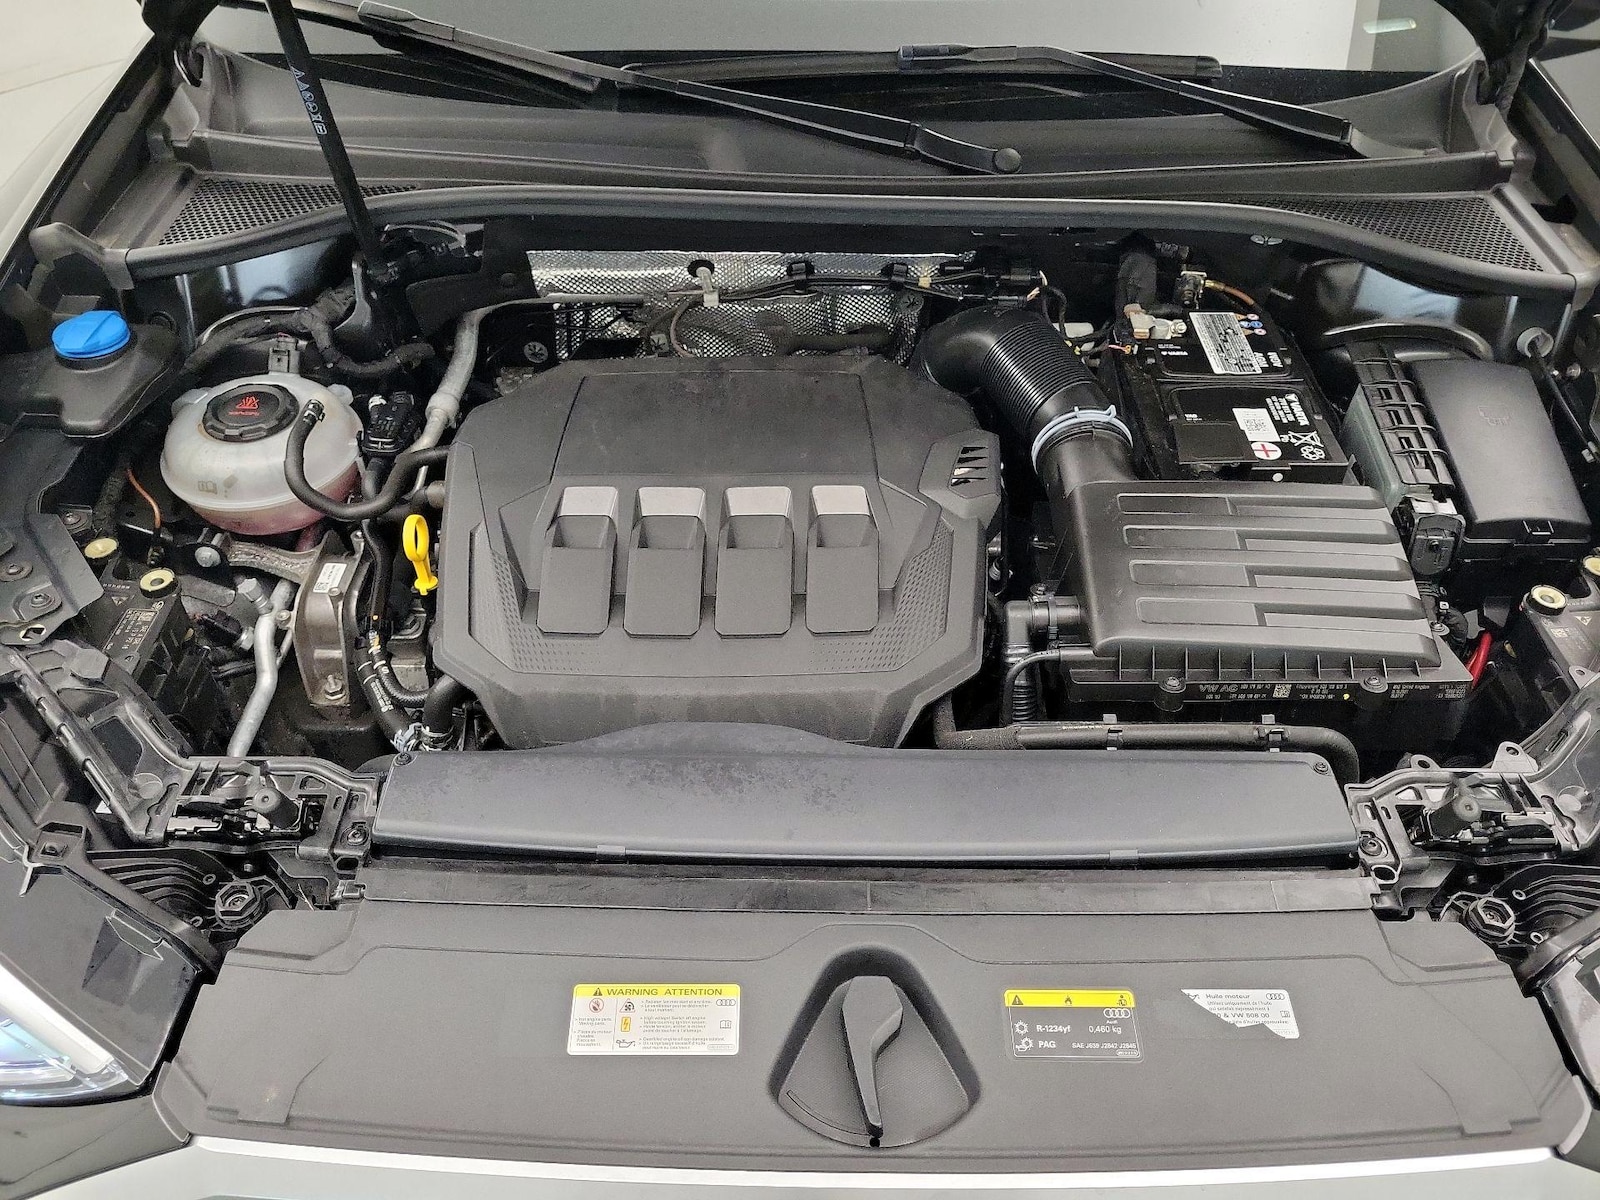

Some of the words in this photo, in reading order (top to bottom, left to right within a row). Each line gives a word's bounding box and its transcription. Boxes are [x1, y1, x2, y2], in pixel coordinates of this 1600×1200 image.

[1290, 402, 1310, 426] VARTA
[606, 988, 658, 996] WARNING
[664, 988, 722, 996] ATTENTION
[1036, 1024, 1071, 1034] R-1234yf
[1088, 1025, 1110, 1034] 0,460
[1112, 1025, 1122, 1034] kg
[1038, 1040, 1056, 1048] PAG
